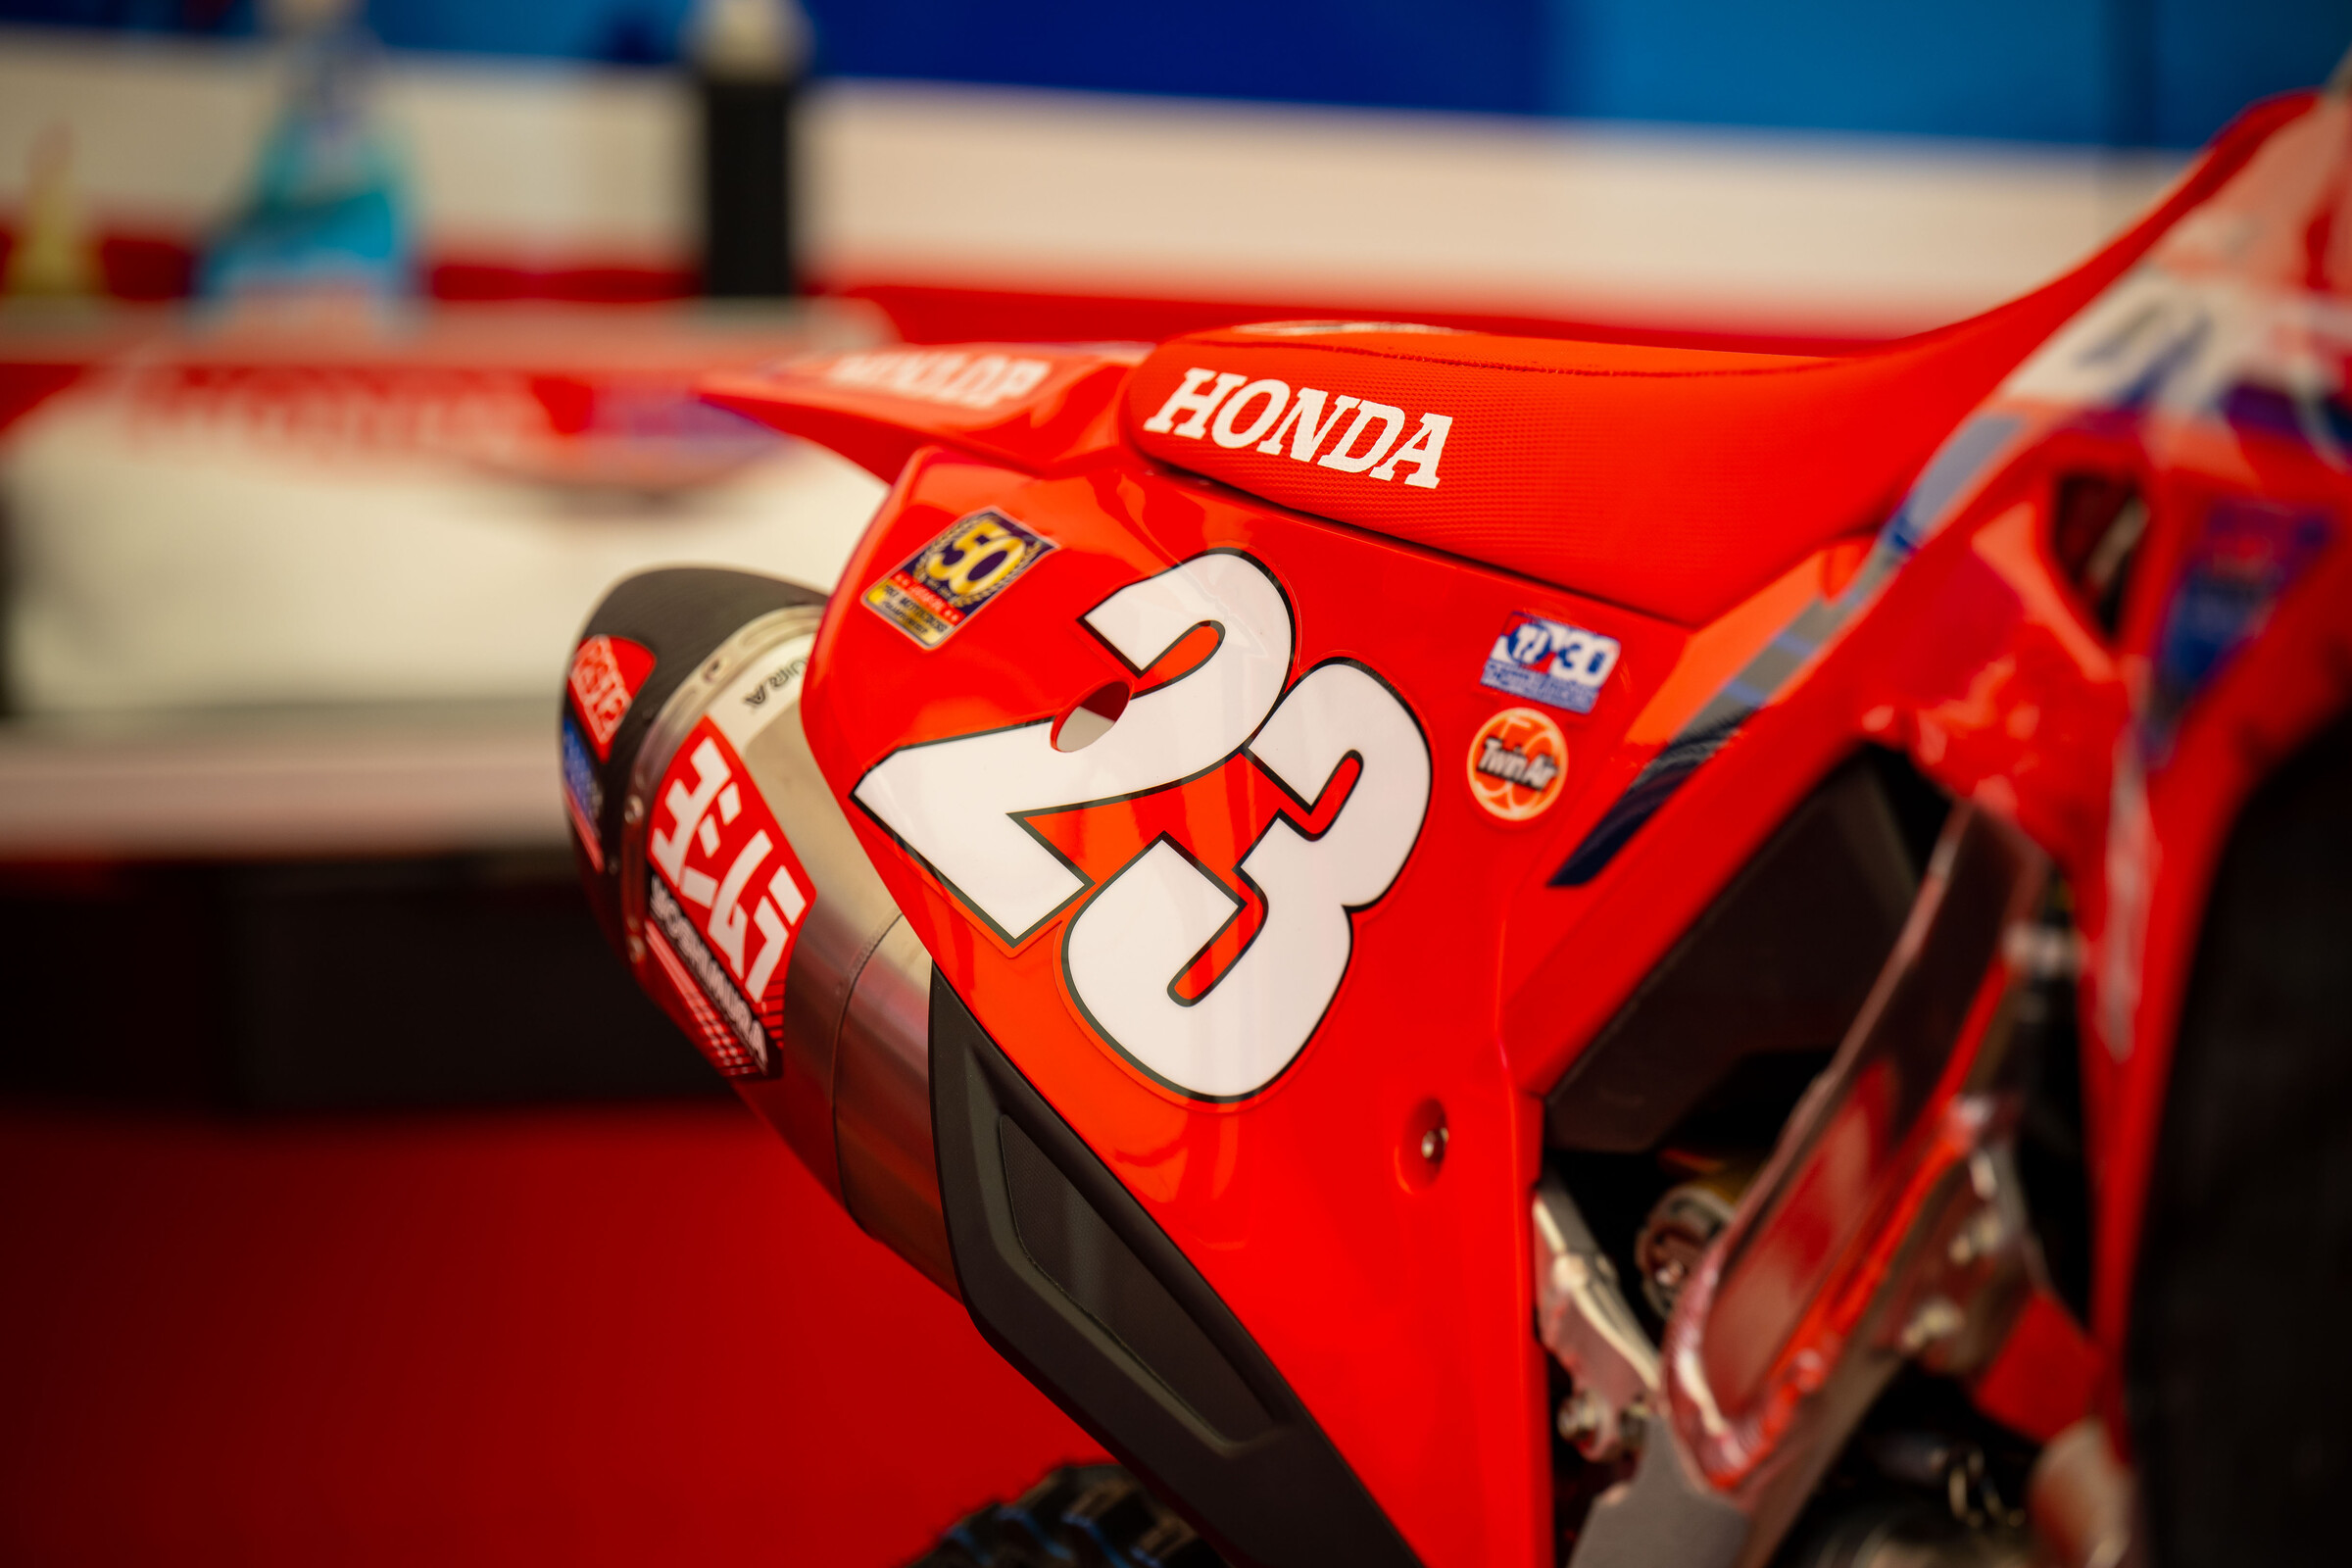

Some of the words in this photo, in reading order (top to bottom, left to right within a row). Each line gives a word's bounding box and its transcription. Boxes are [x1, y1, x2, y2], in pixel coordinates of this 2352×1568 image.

[1143, 368, 1452, 489] HONDA
[926, 521, 1027, 596] 50
[851, 547, 1432, 1103] 23
